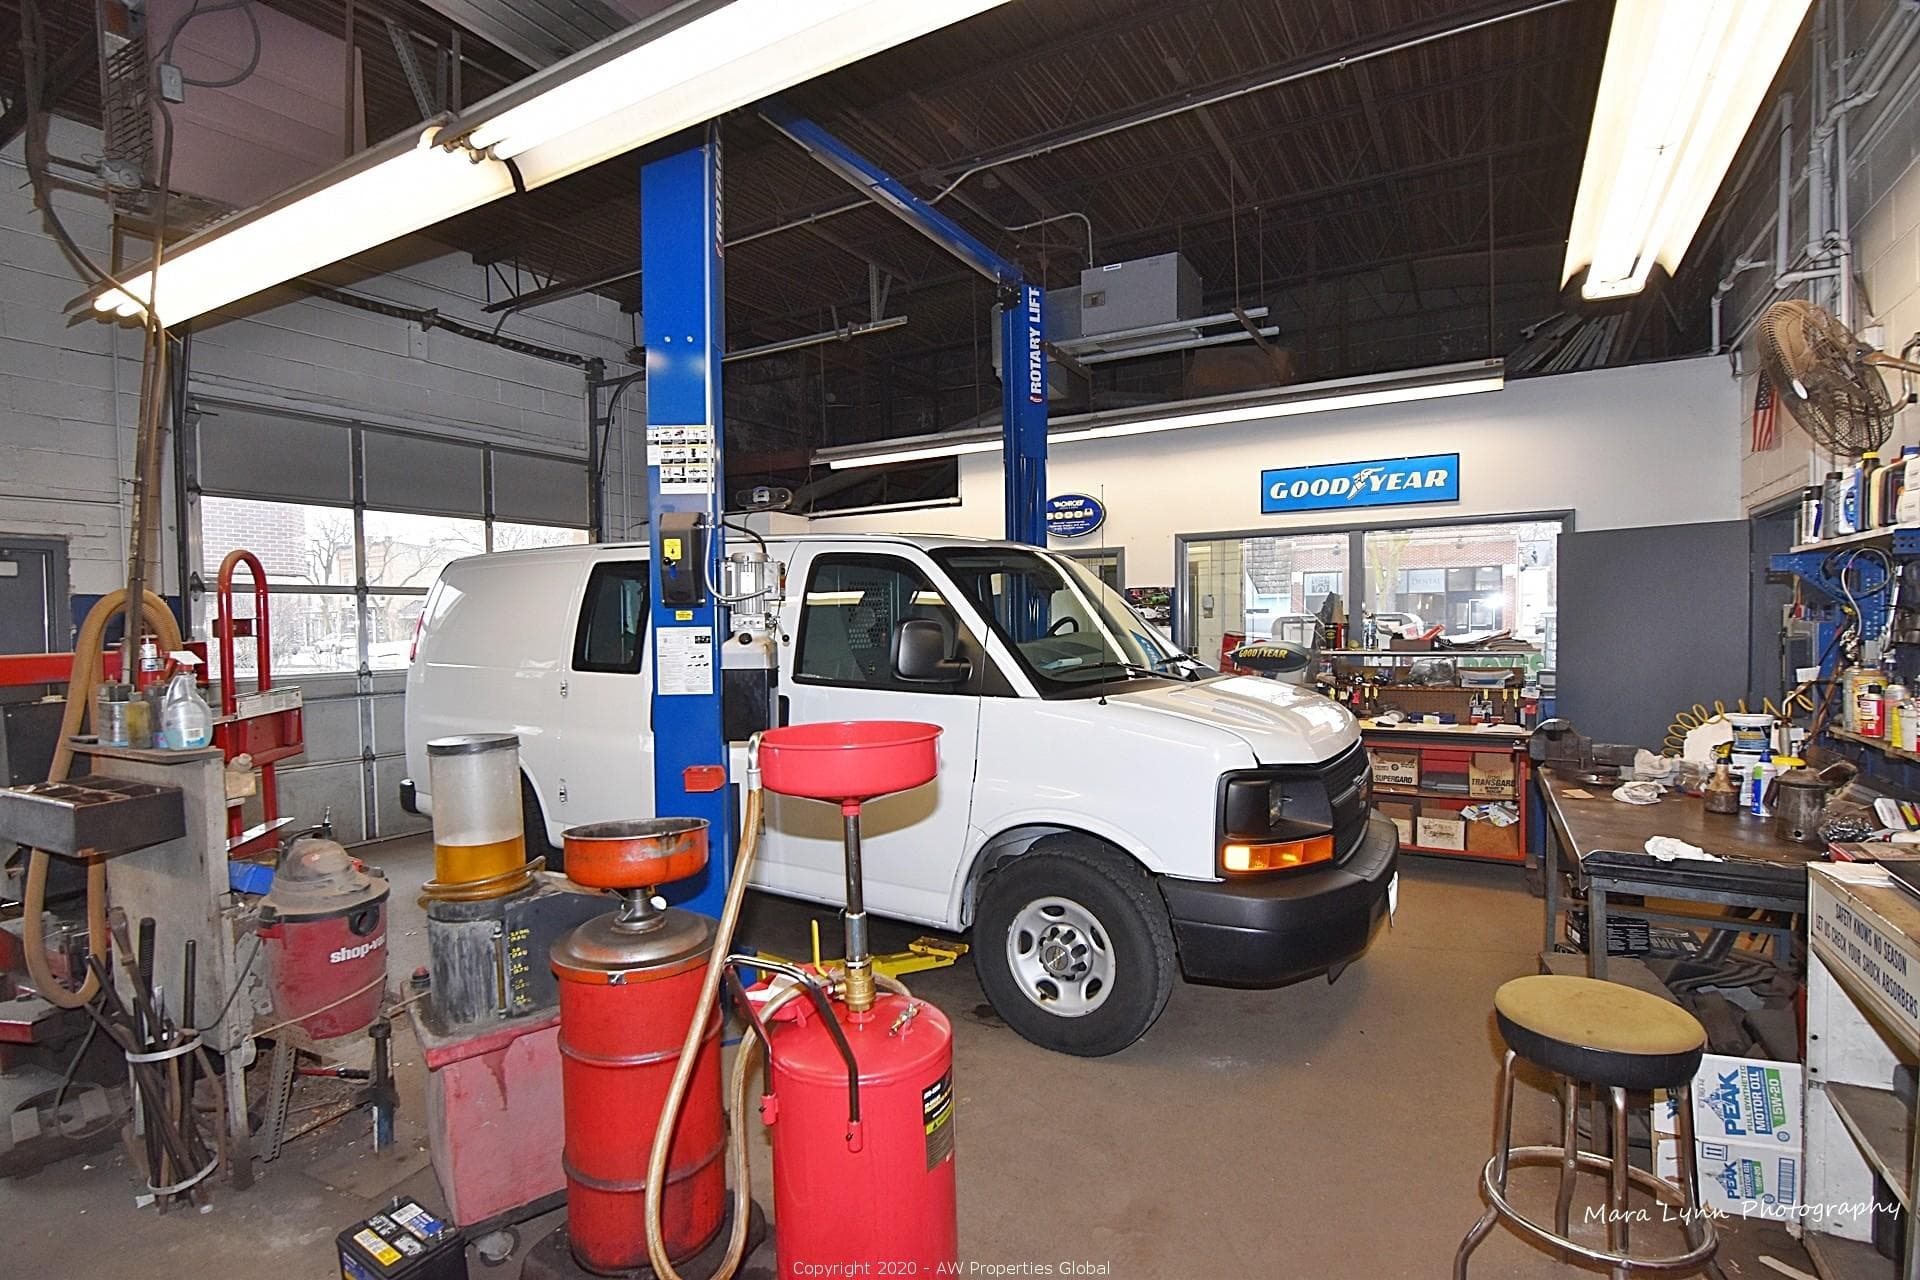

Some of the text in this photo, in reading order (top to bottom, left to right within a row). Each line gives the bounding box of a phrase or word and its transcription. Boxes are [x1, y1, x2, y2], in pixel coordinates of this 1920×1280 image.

[1028, 286, 1042, 394] ROTARY LIFT
[1270, 468, 1449, 500] GOODYEAR
[1238, 647, 1288, 659] GOODYEAR
[1375, 774, 1413, 784] SUPERGARD
[1836, 903, 1907, 977] SAFETY KNOWS NO SEASON
[1832, 926, 1847, 955] CHECK
[1848, 940, 1862, 968] YOUR
[1862, 953, 1881, 986] SHOCK
[1881, 971, 1918, 1020] ABSORBERS
[1740, 1065, 1754, 1132] FULL SYNTHETIC
[1750, 1071, 1761, 1089] OIL
[1770, 1079, 1783, 1114] 5W-20
[1718, 1069, 1747, 1136] PEAK
[1754, 1092, 1766, 1131] MOTOR
[1724, 1161, 1741, 1199] PEAK
